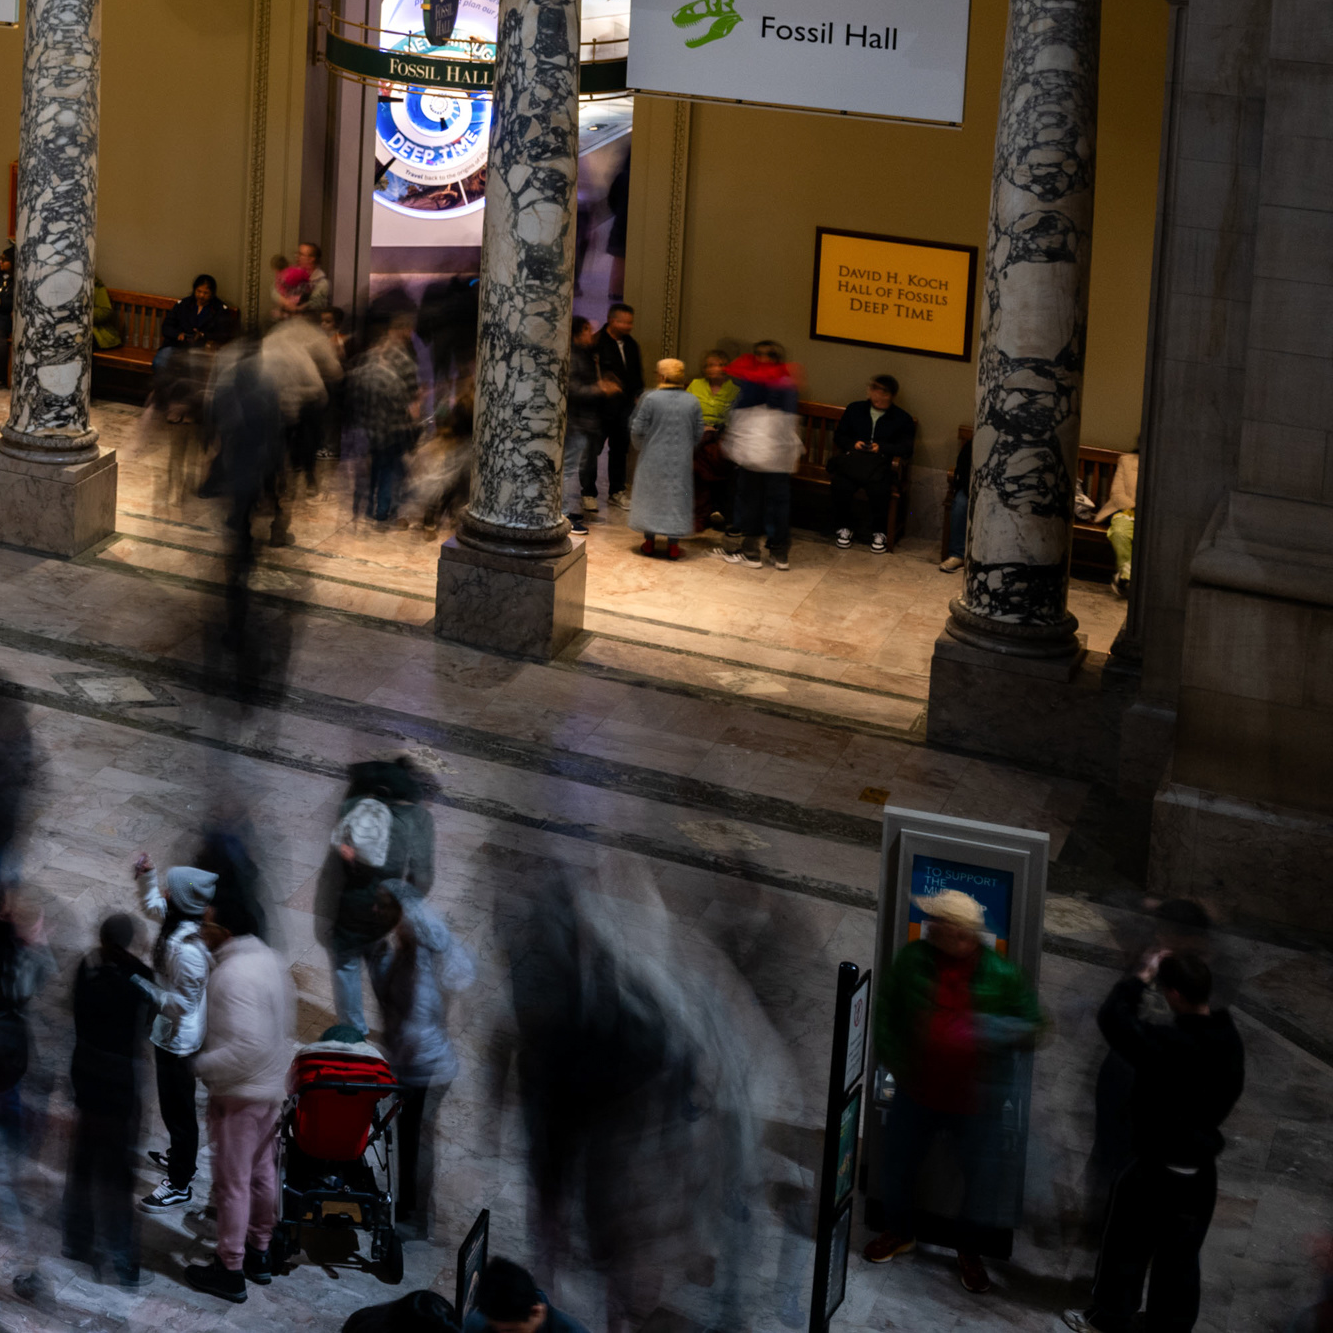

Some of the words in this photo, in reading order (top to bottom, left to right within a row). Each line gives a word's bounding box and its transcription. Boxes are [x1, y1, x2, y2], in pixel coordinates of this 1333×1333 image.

[761, 16, 833, 44] Fossil
[845, 24, 898, 51] Hall
[389, 57, 440, 81] FOSSIL
[446, 65, 494, 85] HALL
[387, 132, 436, 164] DEEP
[439, 129, 478, 159] TIME
[405, 169, 424, 180] Travel
[838, 265, 882, 281] DAVID
[886, 271, 902, 285] H.
[908, 274, 949, 291] KOCH
[838, 280, 872, 296] HALL
[875, 286, 893, 299] OF
[897, 289, 948, 306] FOSSILS
[849, 297, 889, 315] DEEP
[893, 303, 934, 322] TIME
[924, 875, 947, 888] THE
[925, 866, 942, 877] TO
[945, 869, 998, 887] SUPPORT
